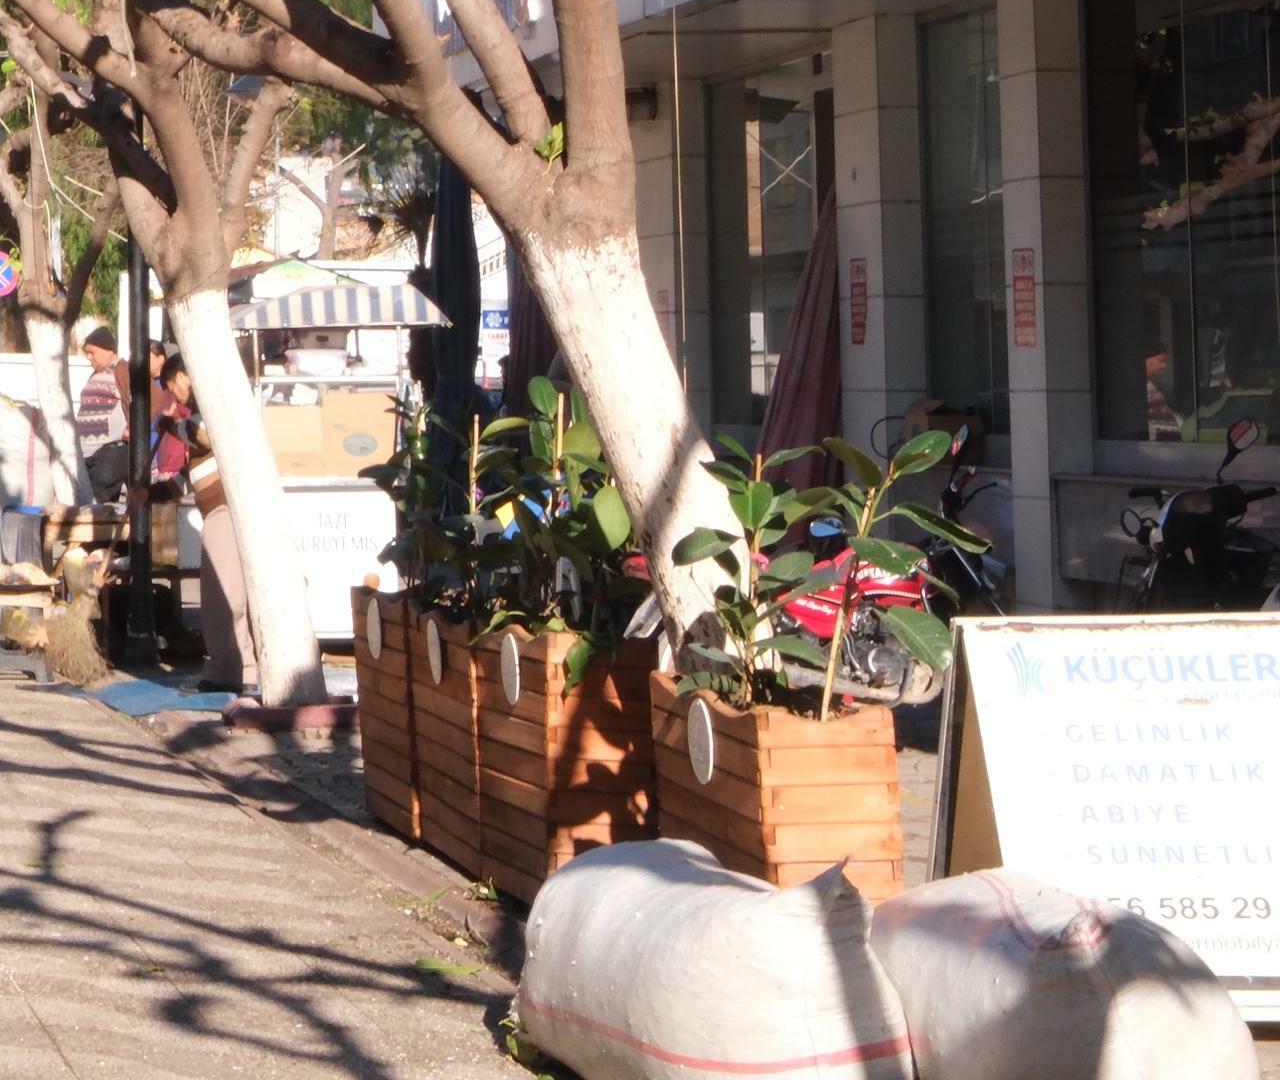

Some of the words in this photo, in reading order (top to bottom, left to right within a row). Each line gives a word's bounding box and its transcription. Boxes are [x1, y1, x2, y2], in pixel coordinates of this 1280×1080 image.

[1062, 647, 1280, 691] KÜÇÜKLER
[1159, 896, 1220, 919] 585
[1231, 896, 1272, 919] 29
